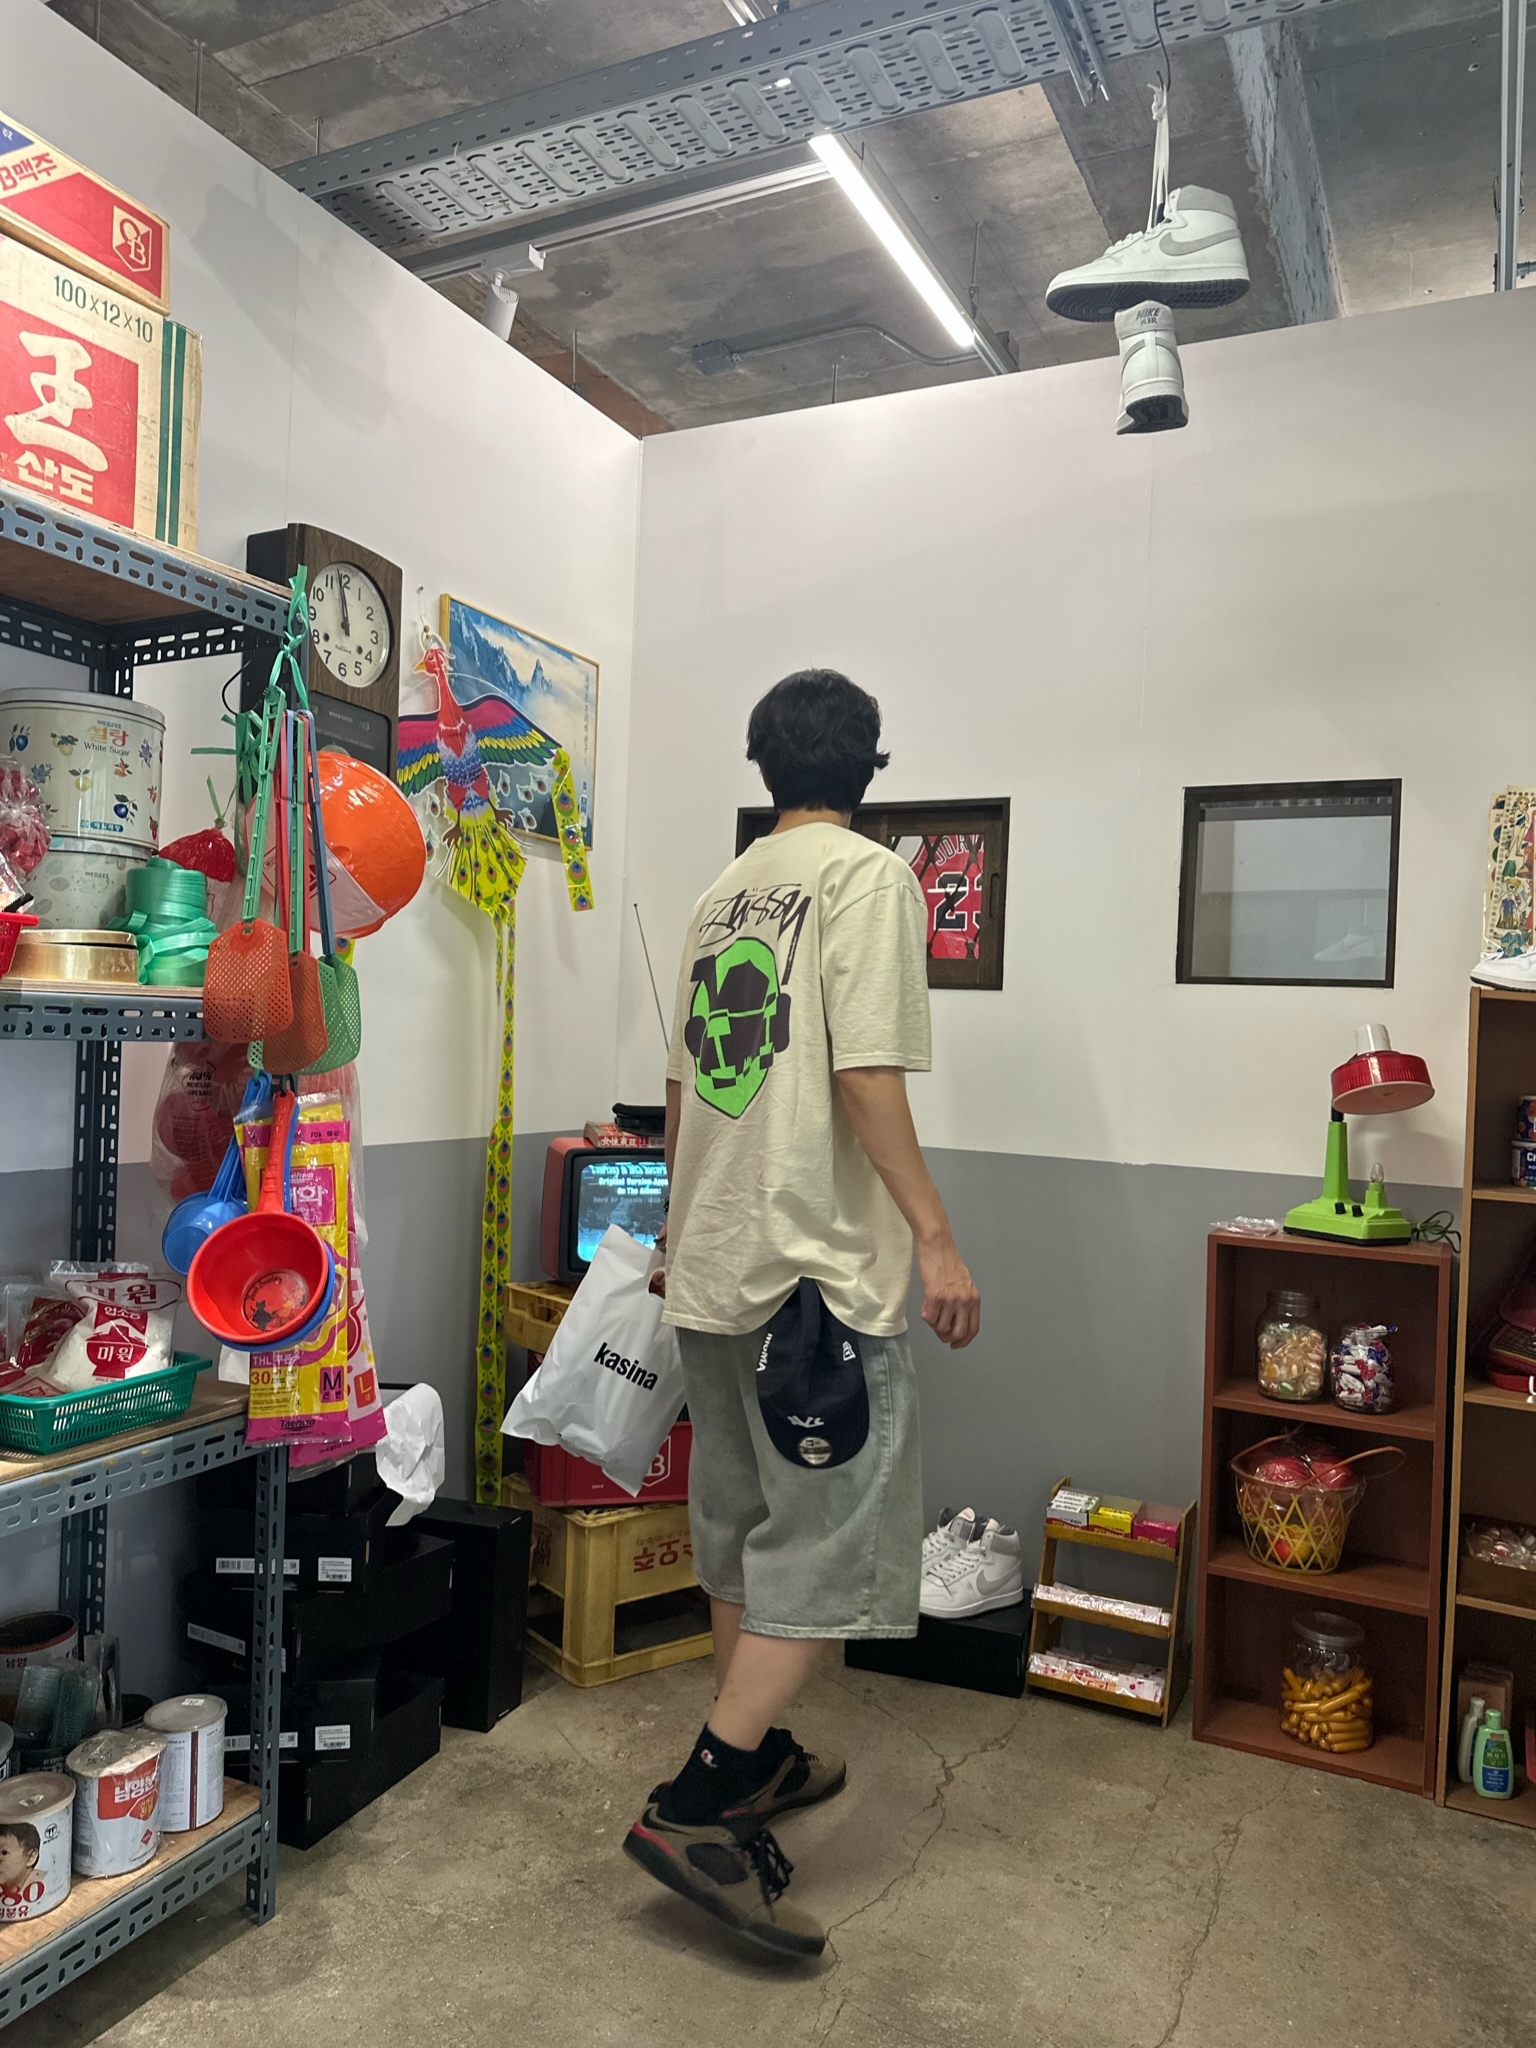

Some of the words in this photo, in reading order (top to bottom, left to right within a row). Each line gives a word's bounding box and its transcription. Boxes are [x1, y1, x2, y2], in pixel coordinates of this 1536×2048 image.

[1136, 308, 1160, 320] NIKE
[1141, 317, 1157, 325] AIR
[14, 450, 94, 505] 산도
[325, 574, 333, 589] 11
[313, 586, 324, 601] 10
[309, 606, 317, 621] 9
[366, 606, 374, 621] 2
[312, 629, 320, 644] 8
[370, 630, 379, 645] 3
[323, 649, 332, 664] 7
[365, 650, 373, 664] 4
[338, 662, 347, 677] 6
[354, 661, 362, 676] 5
[88, 725, 129, 747] 설탕
[84, 742, 106, 752] White
[109, 746, 130, 756] Sugar
[291, 1171, 314, 1179] ehwa
[97, 1346, 134, 1363] 미원
[594, 1342, 658, 1391] kasina
[251, 1371, 270, 1384] 30
[323, 1370, 341, 1390] M
[359, 1376, 373, 1394] L
[0, 1881, 45, 1906] 80
